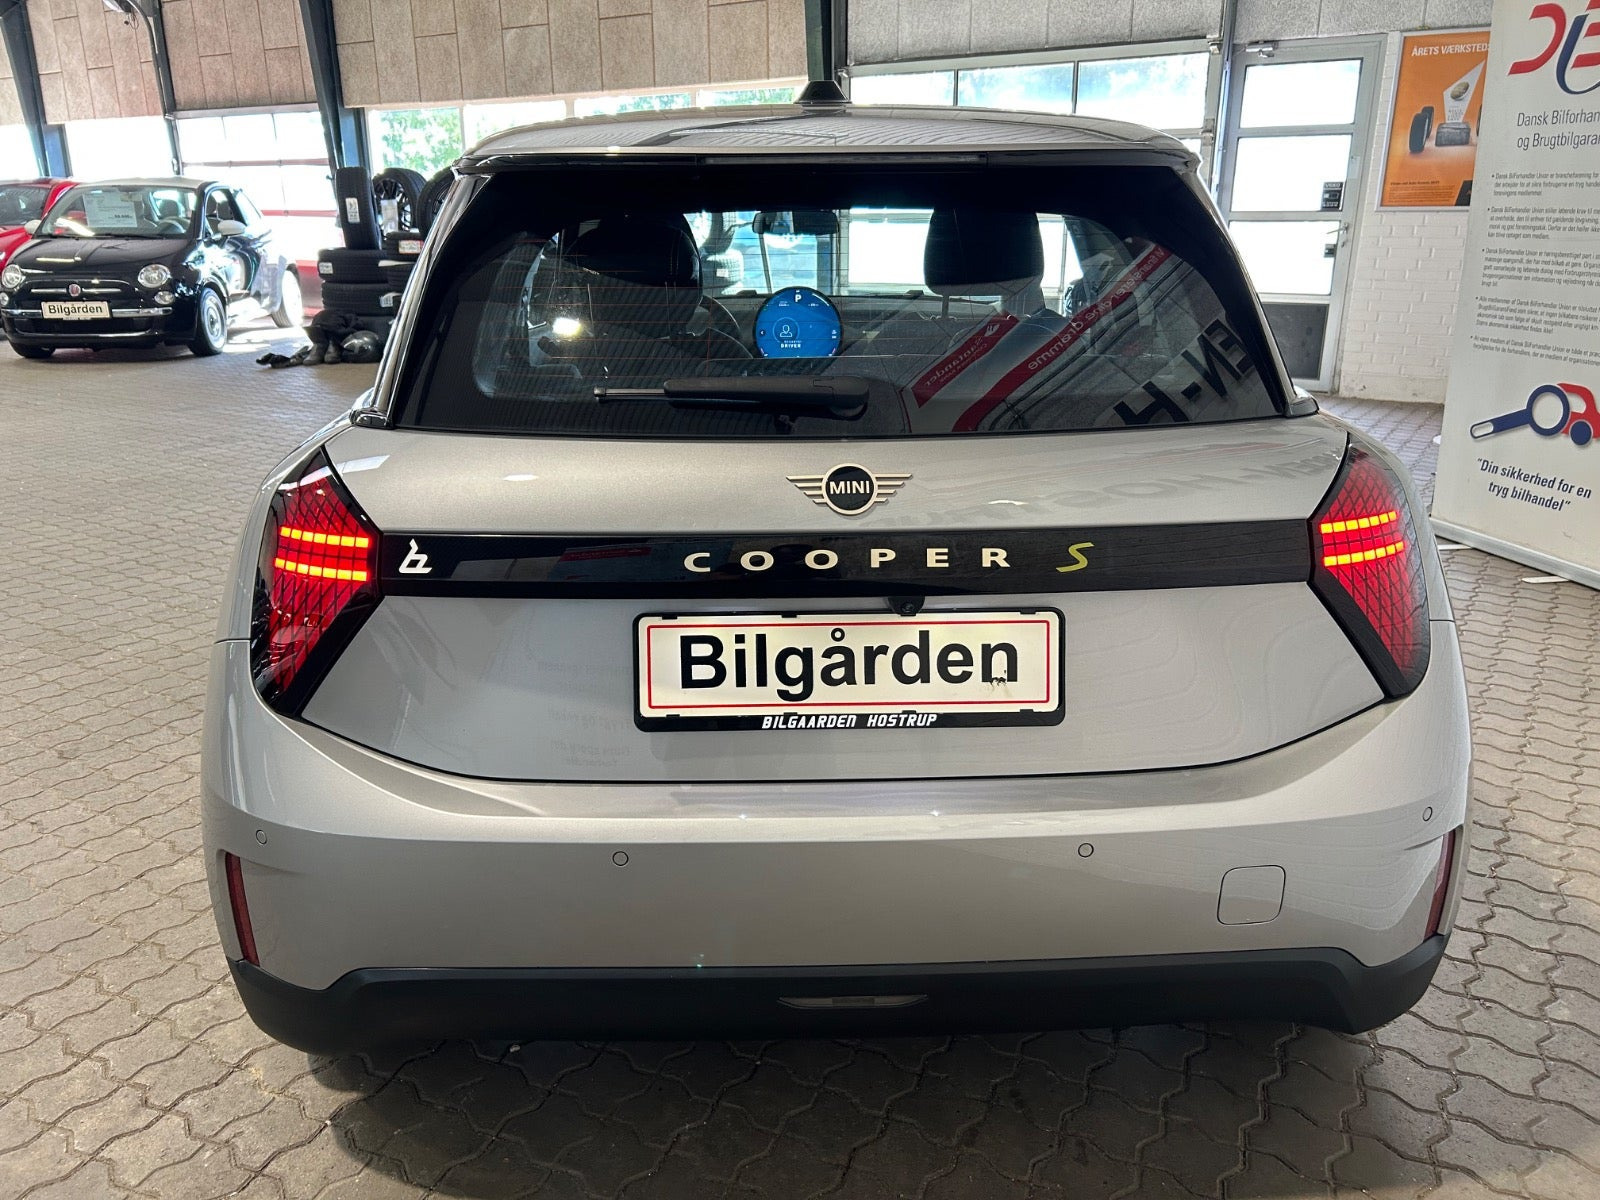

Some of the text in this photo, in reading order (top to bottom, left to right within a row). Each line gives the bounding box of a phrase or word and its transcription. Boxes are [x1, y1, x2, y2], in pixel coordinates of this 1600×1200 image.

[1411, 45, 1440, 57] ÅRETS
[1517, 111, 1549, 127] Dansk
[1517, 137, 1530, 151] og
[794, 294, 802, 303] P
[48, 303, 103, 316] Bilgården
[829, 480, 870, 495] MINI
[1488, 481, 1509, 499] tryg
[1500, 465, 1557, 489] sikkerhed
[1557, 478, 1575, 494] for
[1576, 487, 1592, 499] en
[683, 541, 1095, 573] COOPER S
[679, 627, 1018, 702] Bilgården
[761, 713, 938, 730] BILGAARDEN HOSTRUP
